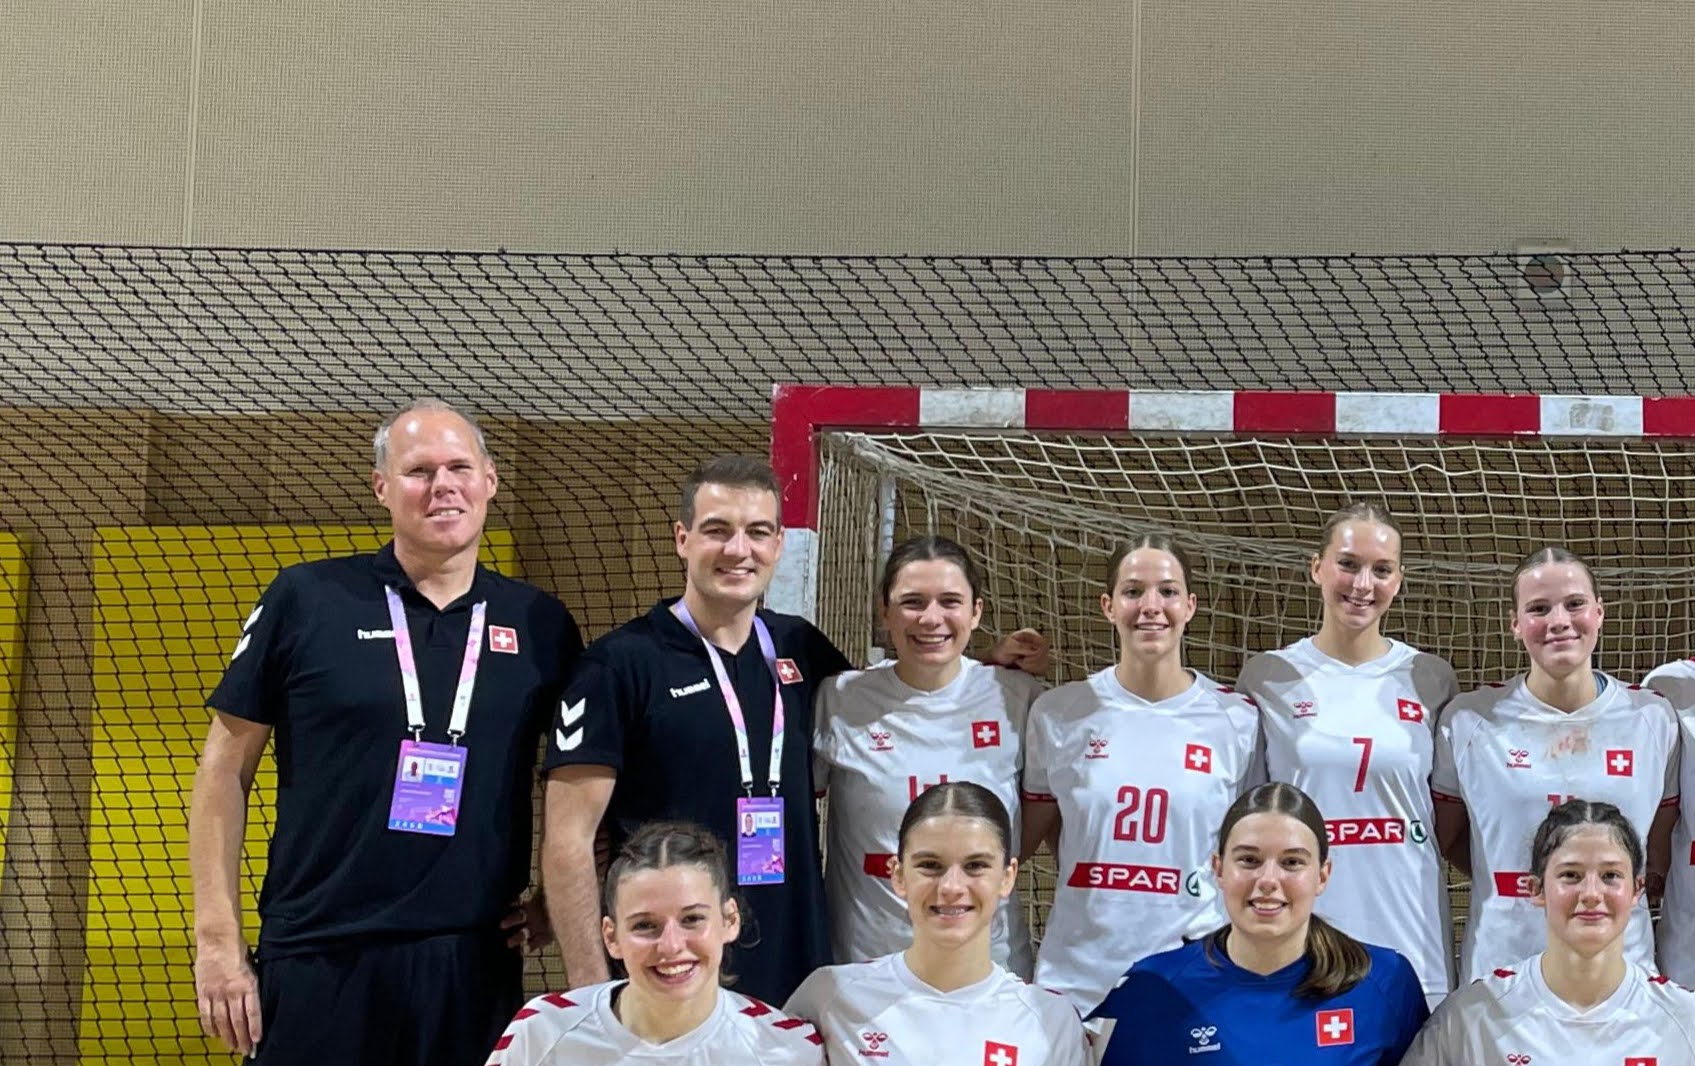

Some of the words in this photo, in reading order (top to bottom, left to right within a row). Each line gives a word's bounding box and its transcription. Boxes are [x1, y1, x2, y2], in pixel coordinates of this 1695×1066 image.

[1353, 737, 1373, 793] 7
[1113, 785, 1169, 844] 20
[1089, 866, 1178, 891] SPAR
